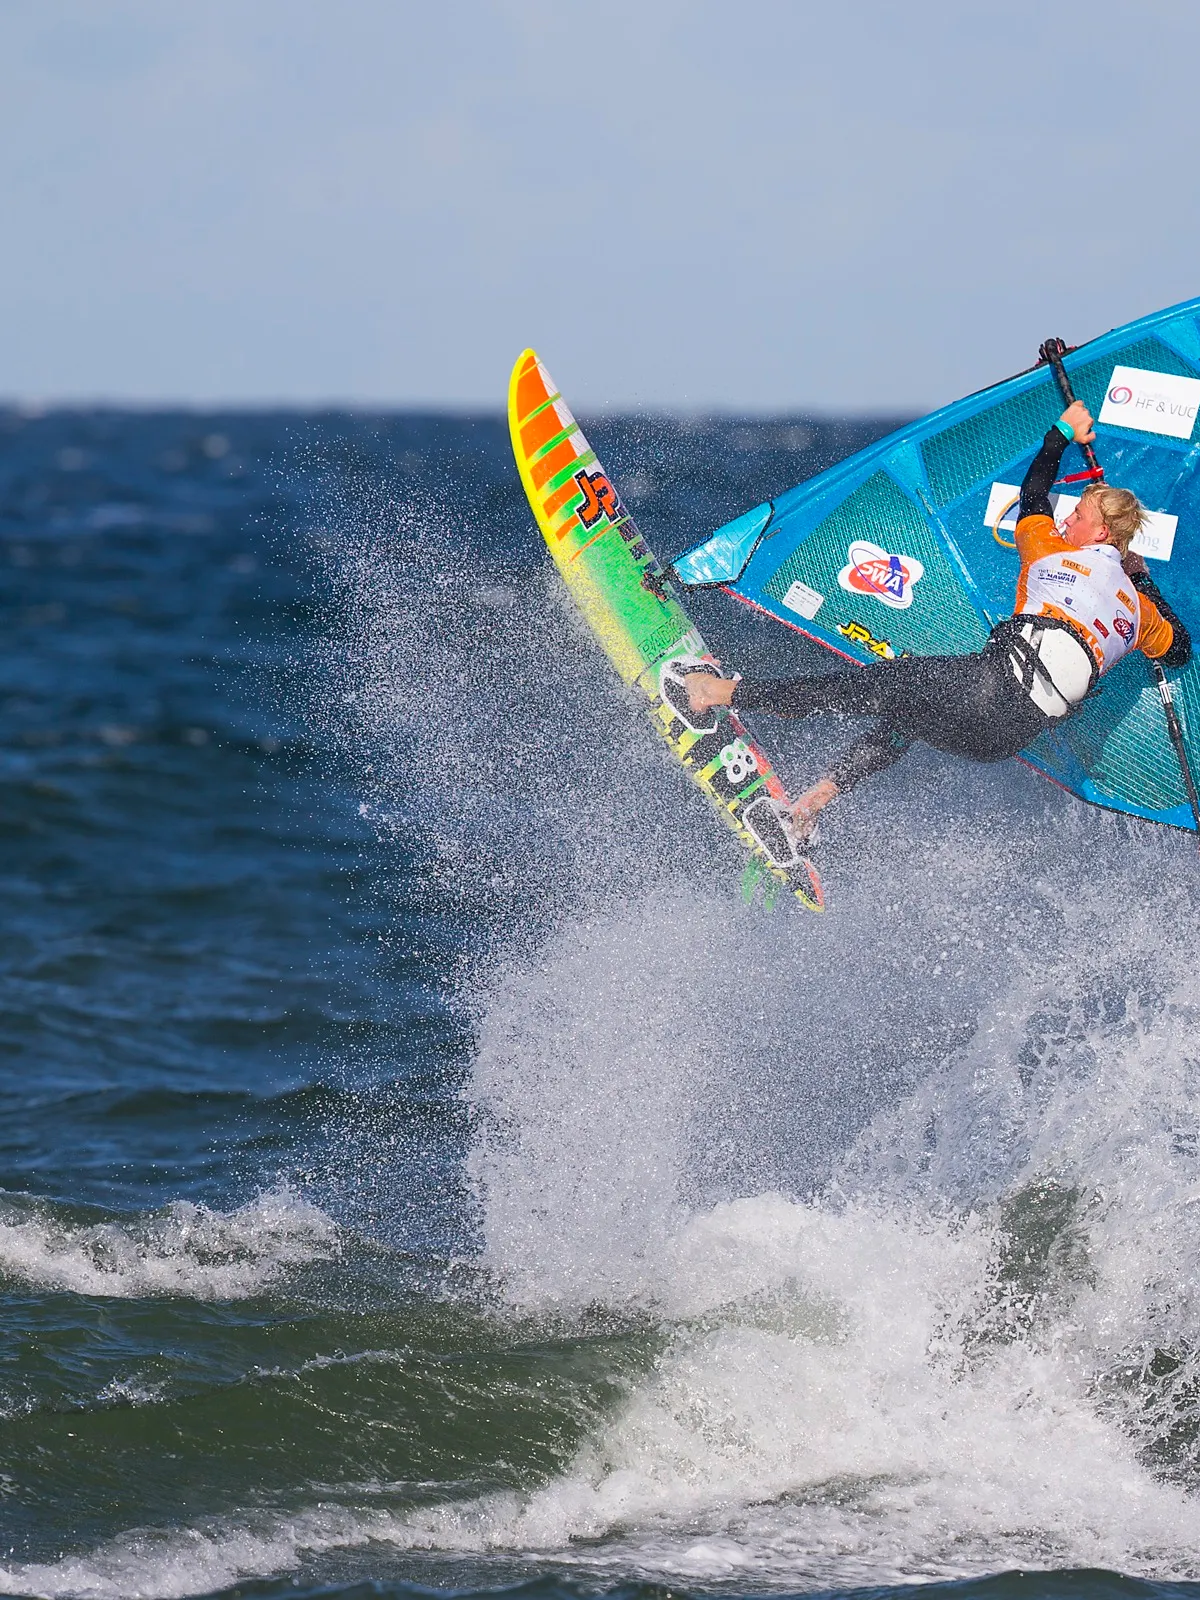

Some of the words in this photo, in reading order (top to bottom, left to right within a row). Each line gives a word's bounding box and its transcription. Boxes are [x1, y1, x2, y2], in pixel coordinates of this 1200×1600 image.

[1135, 397, 1154, 409] HF
[1155, 401, 1165, 412] &
[1170, 403, 1196, 418] VUC
[574, 469, 620, 530] JP
[856, 563, 901, 592] PWA
